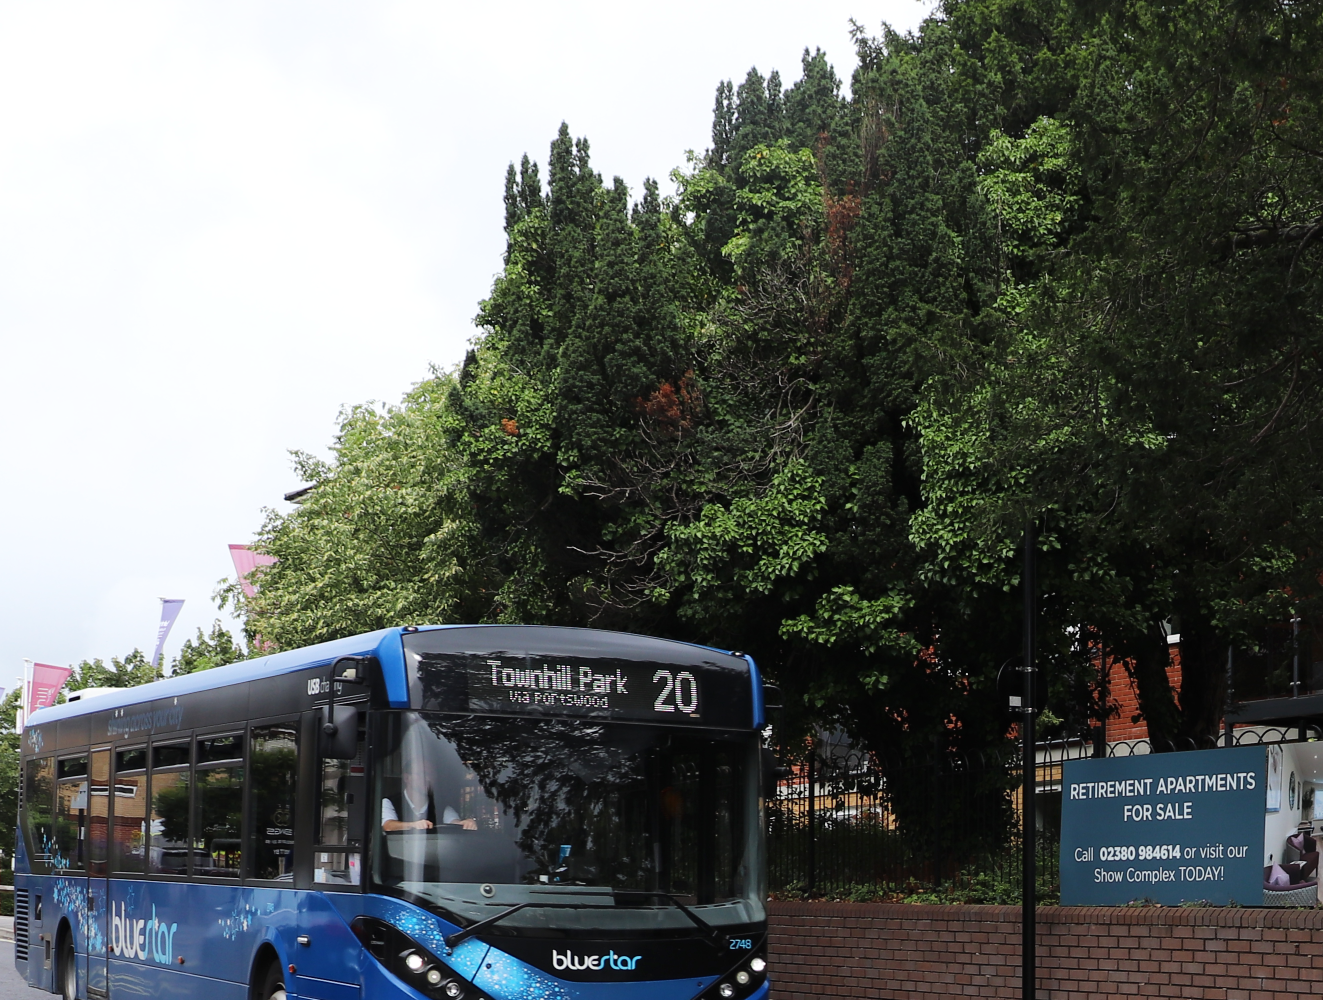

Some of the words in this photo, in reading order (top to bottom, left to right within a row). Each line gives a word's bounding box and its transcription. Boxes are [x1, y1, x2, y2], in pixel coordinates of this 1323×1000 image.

[307, 678, 320, 695] USB
[486, 659, 573, 691] Townhill
[578, 666, 629, 694] Park
[652, 669, 698, 713] 20
[1070, 778, 1153, 800] RETIREMENT
[1156, 772, 1256, 795] APARTMENTS
[1124, 804, 1152, 822] FOR
[1156, 802, 1193, 820] SALE
[1074, 847, 1094, 862] Call
[1099, 846, 1136, 861] 02380
[1138, 844, 1181, 860] 984614
[1184, 847, 1197, 859] or
[1200, 843, 1224, 859] visit
[1227, 845, 1248, 859] our
[1094, 868, 1124, 883] Show
[1126, 866, 1176, 885] Complex
[1179, 866, 1225, 881] TODAY!
[112, 900, 178, 966] bluestar
[729, 939, 752, 950] 2748
[552, 949, 643, 971] bluestar
